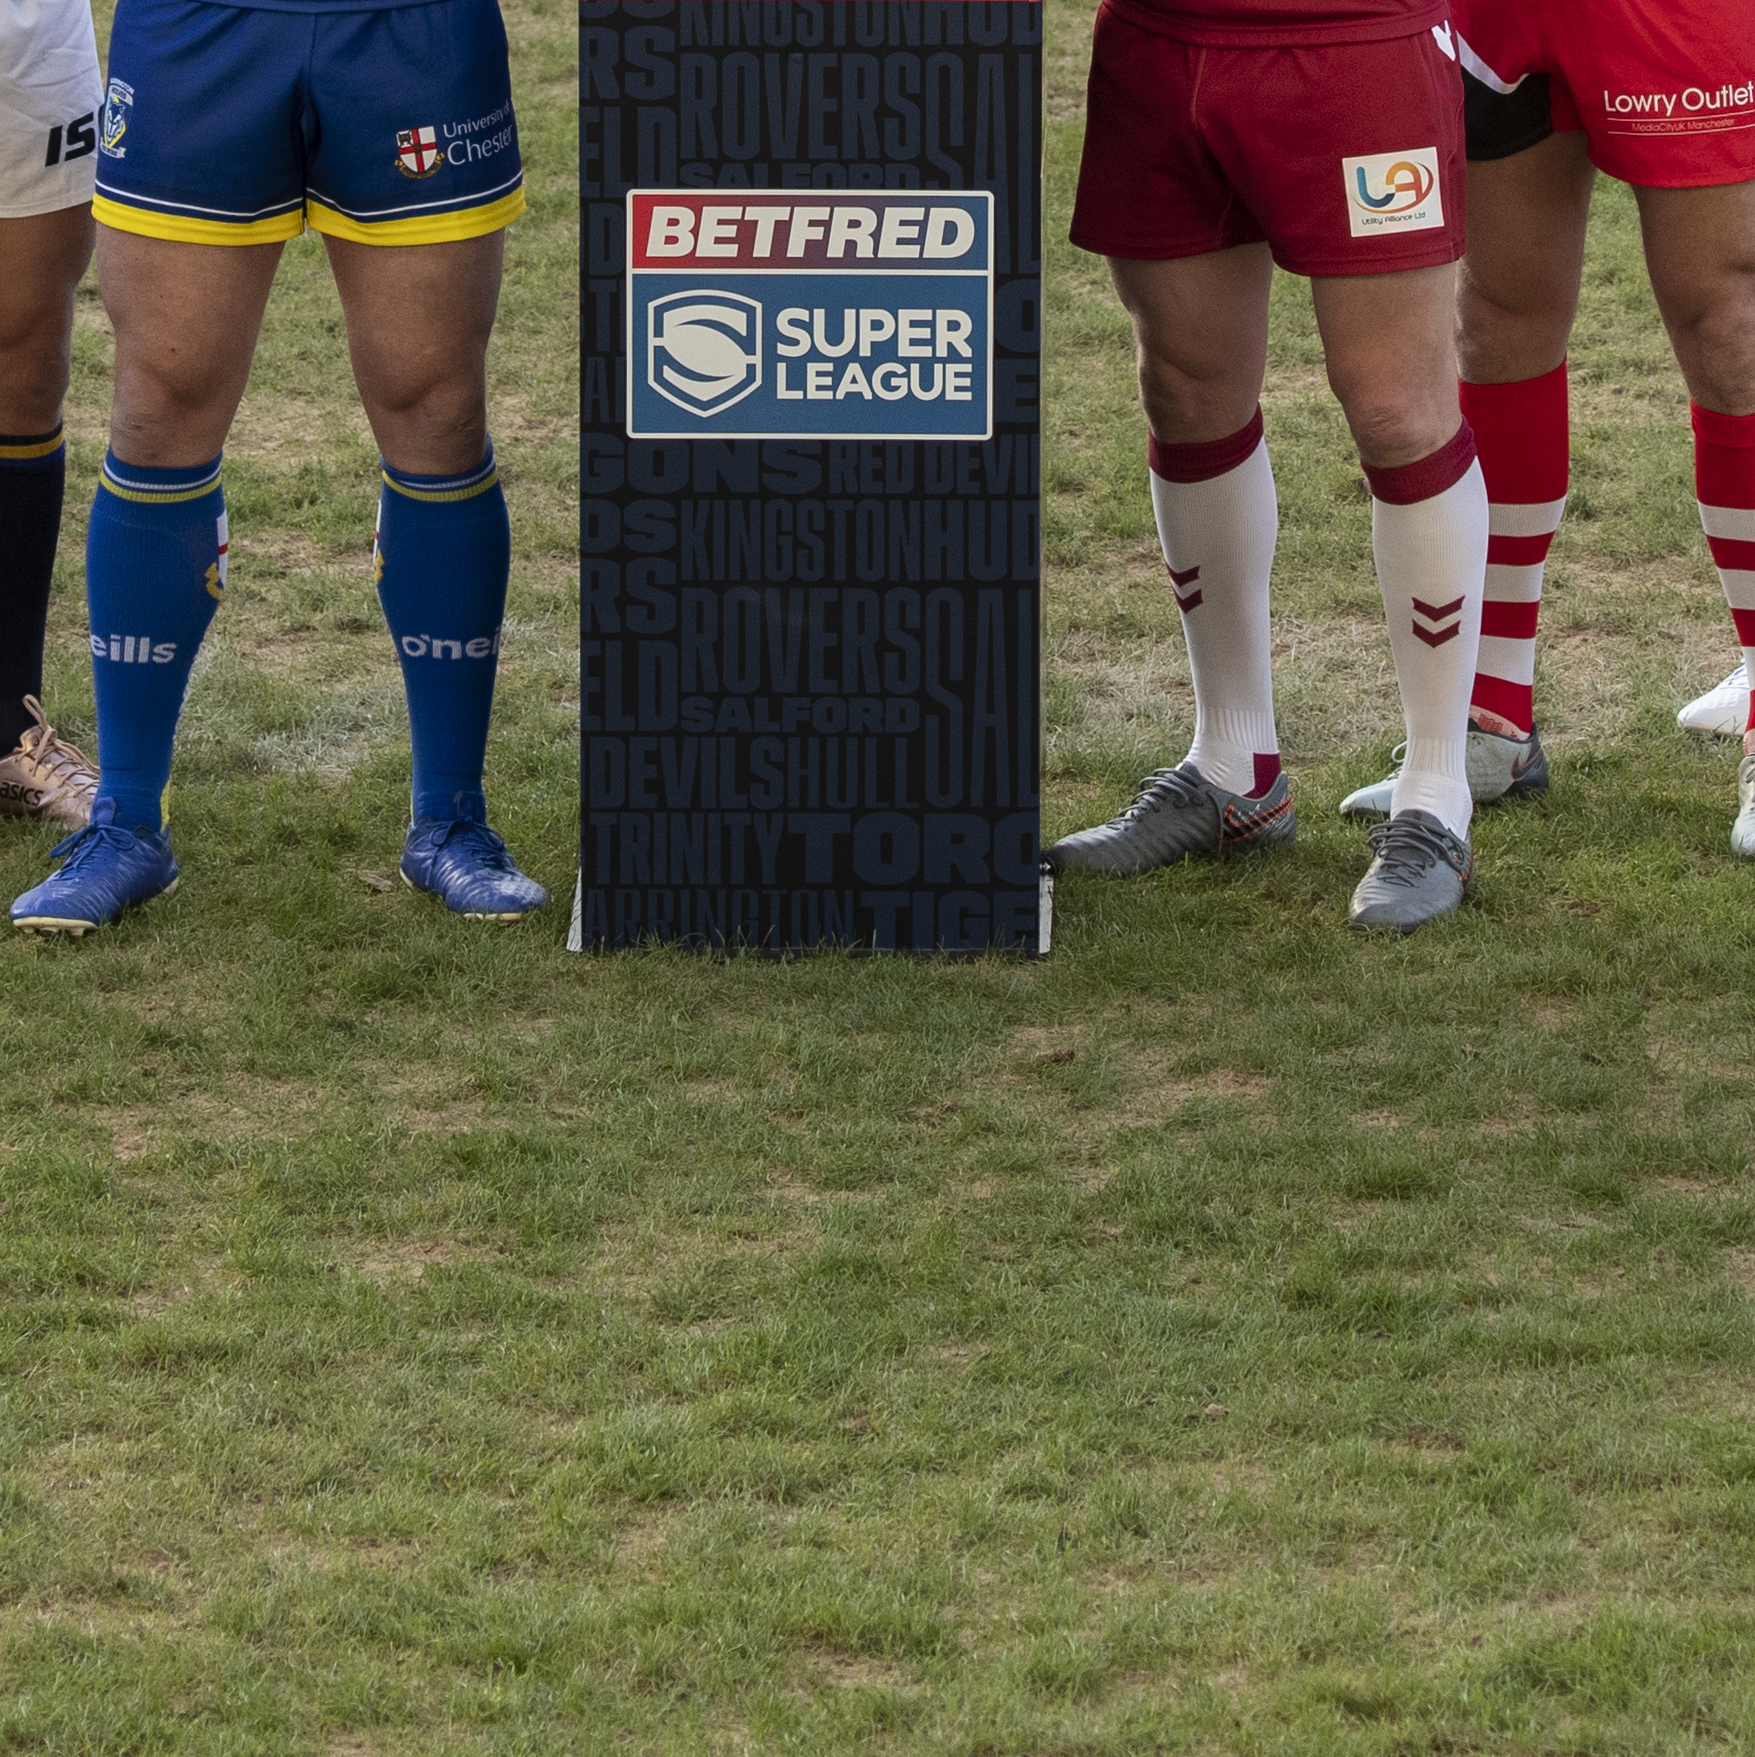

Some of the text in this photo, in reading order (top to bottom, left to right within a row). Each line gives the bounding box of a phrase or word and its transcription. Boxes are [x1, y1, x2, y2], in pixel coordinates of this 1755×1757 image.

[1604, 81, 1755, 117] Lowry Outlet
[443, 106, 502, 139] University
[1687, 117, 1735, 129] Manchester
[446, 124, 514, 167] Chester
[645, 205, 975, 259] BETFRED
[1361, 211, 1427, 227] Utility Alliance Ltd
[775, 307, 973, 358] SUPER
[775, 362, 973, 401] LEAGUE
